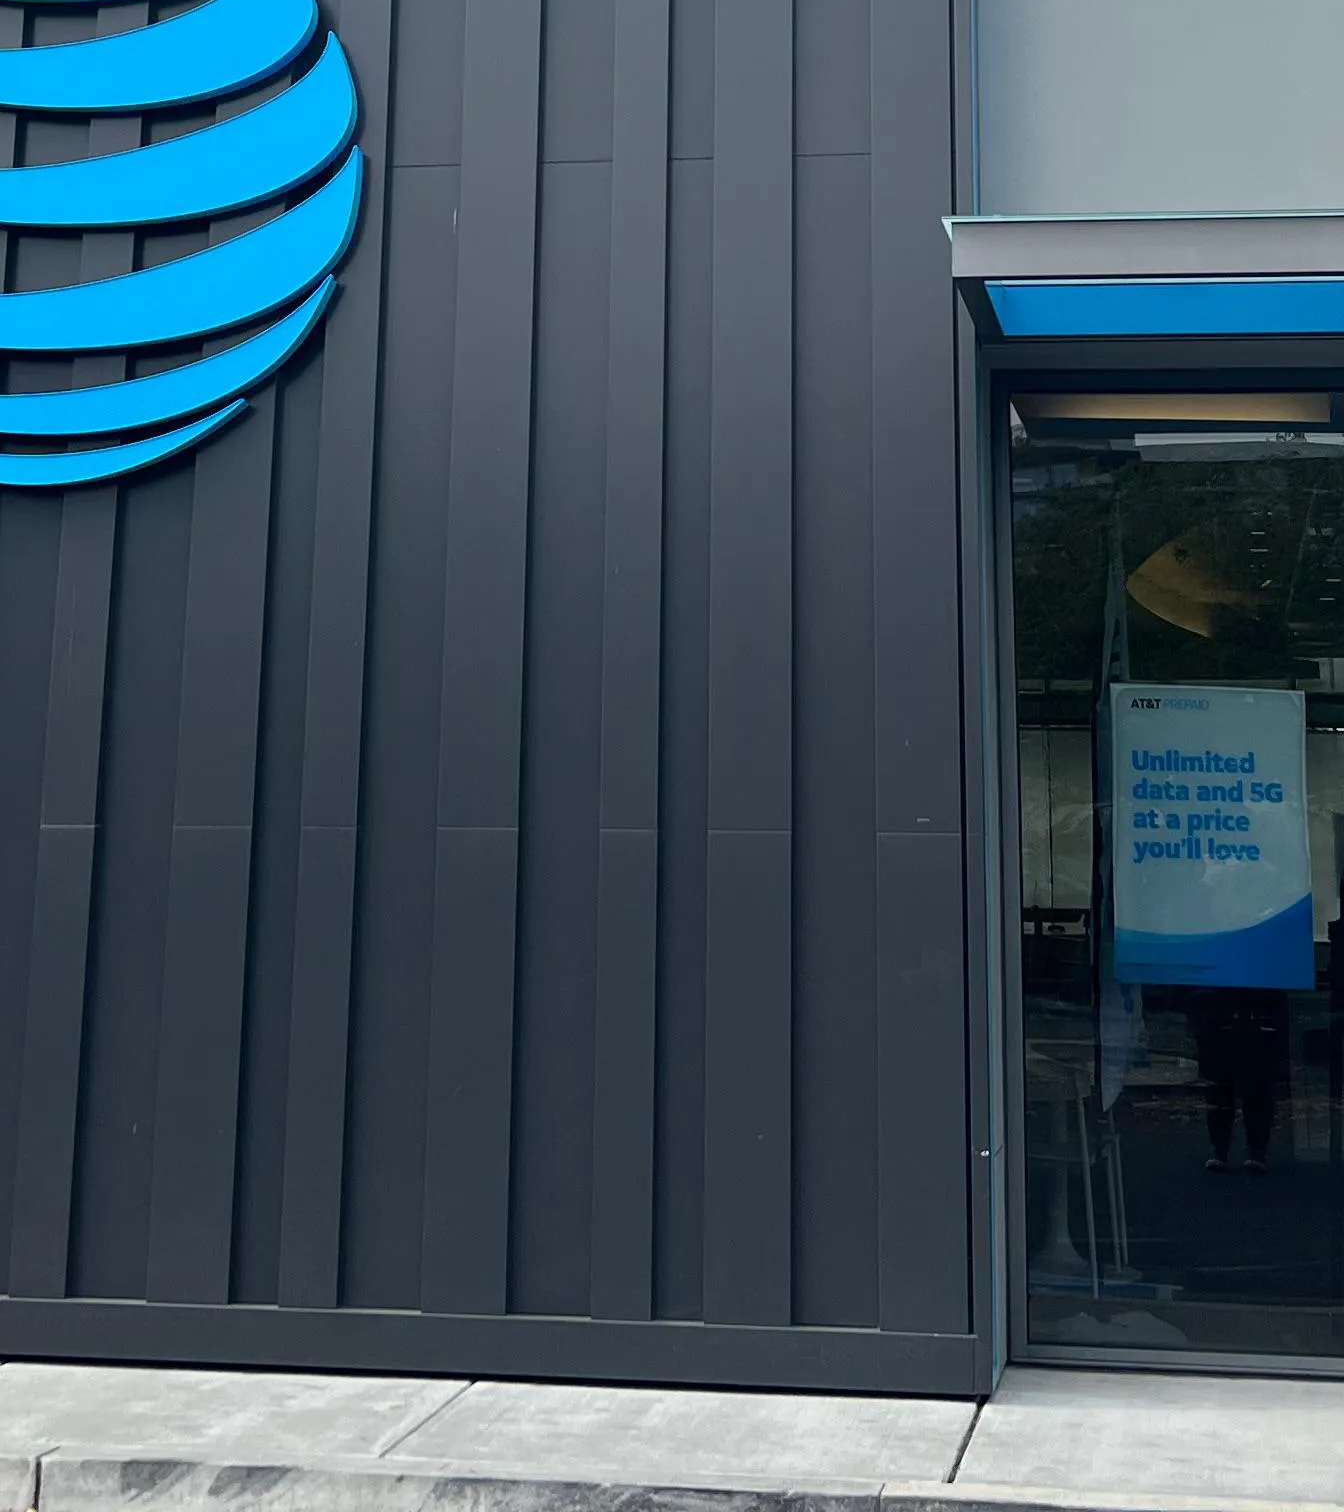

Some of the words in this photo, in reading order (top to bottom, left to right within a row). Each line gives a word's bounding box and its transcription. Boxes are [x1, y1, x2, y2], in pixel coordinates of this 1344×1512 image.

[1131, 698, 1161, 709] AT&T
[1131, 749, 1255, 774] Unlimited
[1132, 777, 1190, 801] data
[1197, 780, 1244, 803] and
[1250, 782, 1284, 803] 5G
[1133, 809, 1160, 830] at
[1165, 813, 1181, 830] a
[1187, 808, 1250, 837] price
[1133, 837, 1201, 864] you'll
[1207, 838, 1261, 861] love
